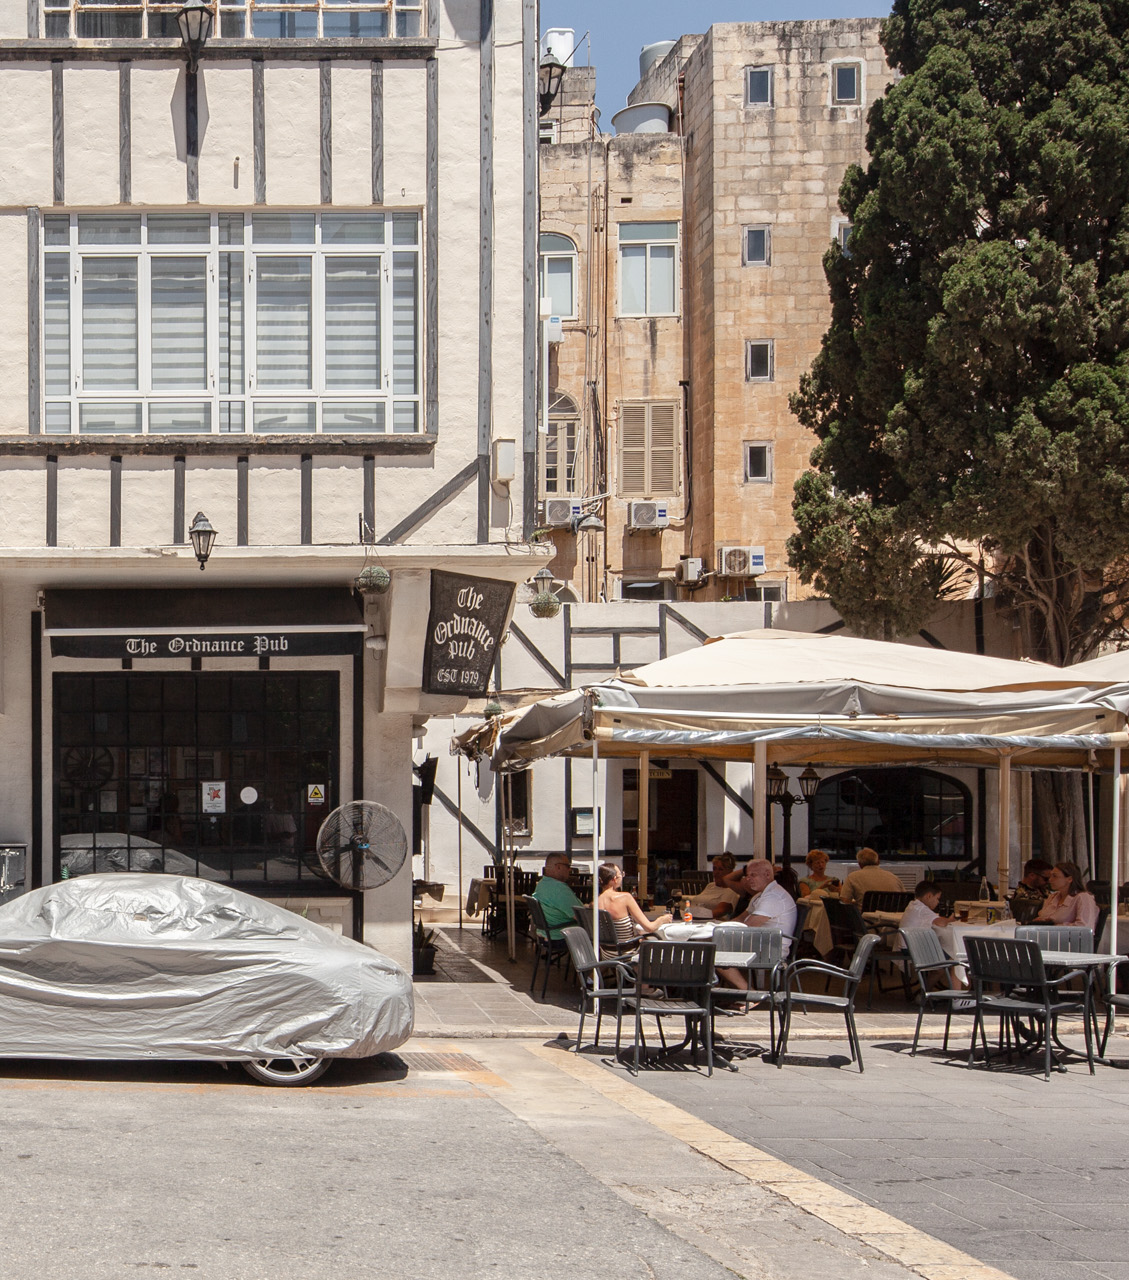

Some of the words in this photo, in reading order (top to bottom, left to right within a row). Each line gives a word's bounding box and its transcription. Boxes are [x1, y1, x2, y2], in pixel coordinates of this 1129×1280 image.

[457, 586, 484, 611] The
[434, 612, 494, 652] Ordnance
[125, 638, 157, 656] The
[168, 637, 245, 653] Ordnance
[253, 635, 289, 654] Pub
[437, 669, 458, 683] EST
[460, 670, 479, 685] 1979
